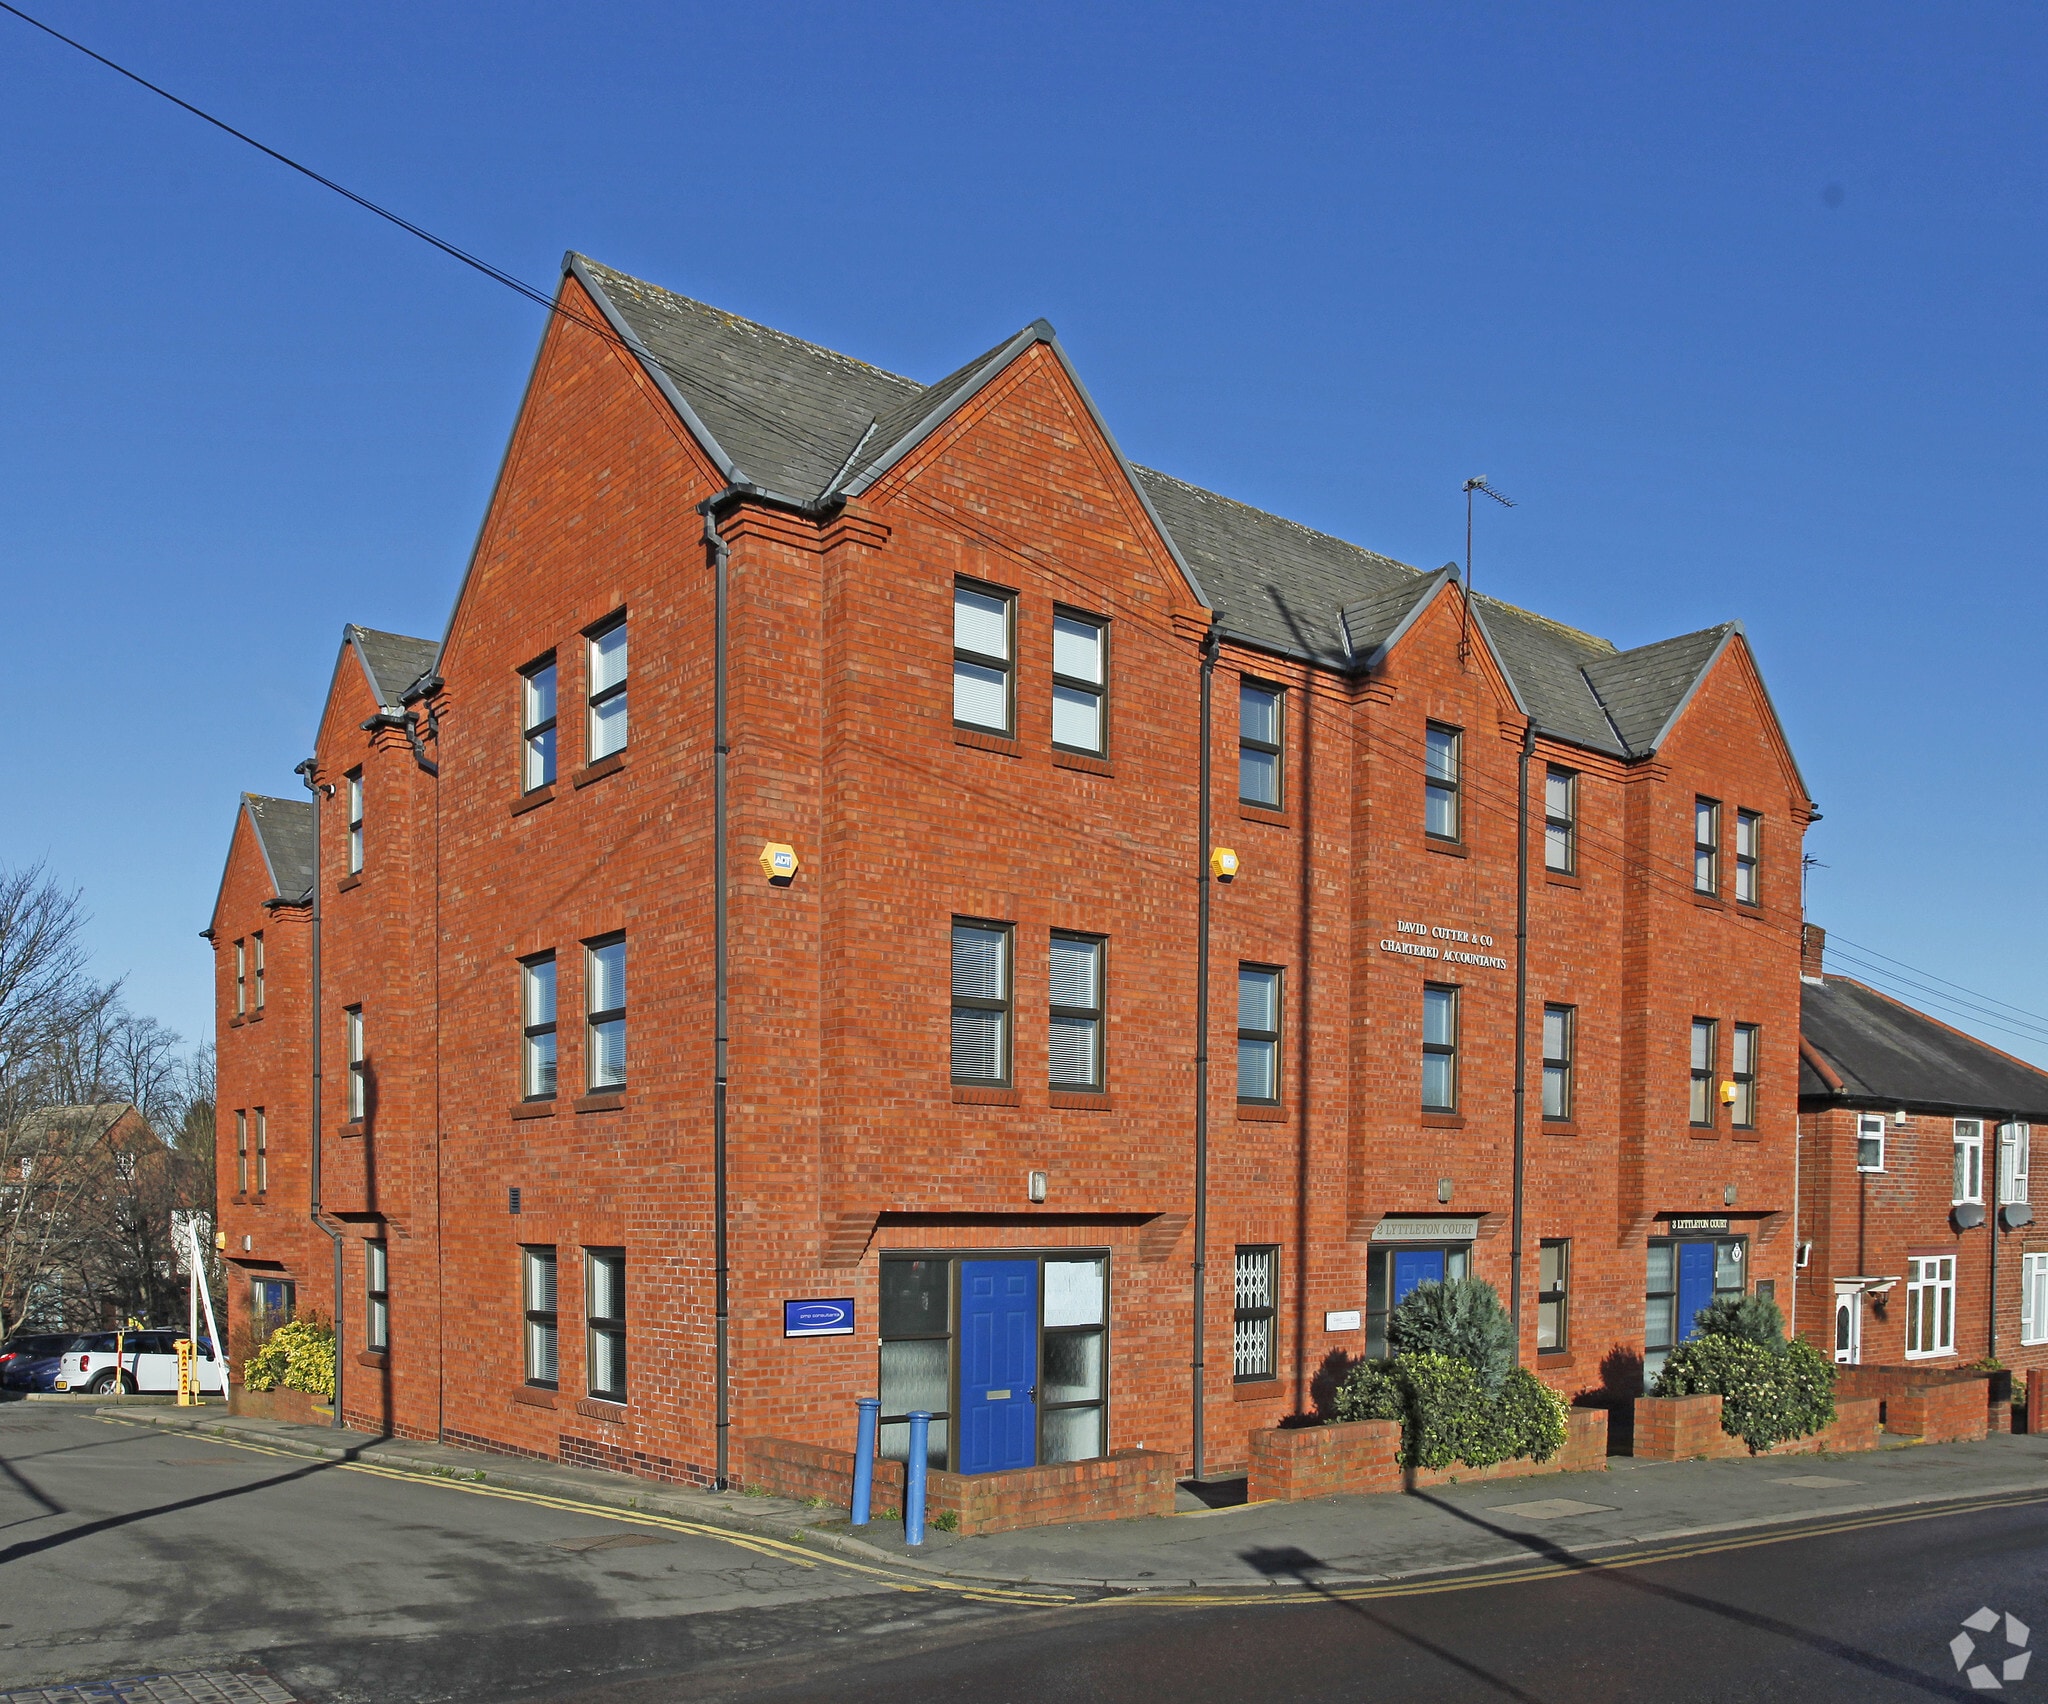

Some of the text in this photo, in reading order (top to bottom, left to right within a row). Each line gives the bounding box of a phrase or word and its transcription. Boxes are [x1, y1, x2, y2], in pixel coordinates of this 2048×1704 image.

[775, 855, 791, 866] ADT
[1397, 920, 1493, 947] DAVID CUTTER & CO
[1380, 939, 1507, 970] CHARTERED ACCOUNTANTS
[1377, 1223, 1474, 1235] 2 LYTTLETON COURT
[1710, 1219, 1727, 1228] COURT
